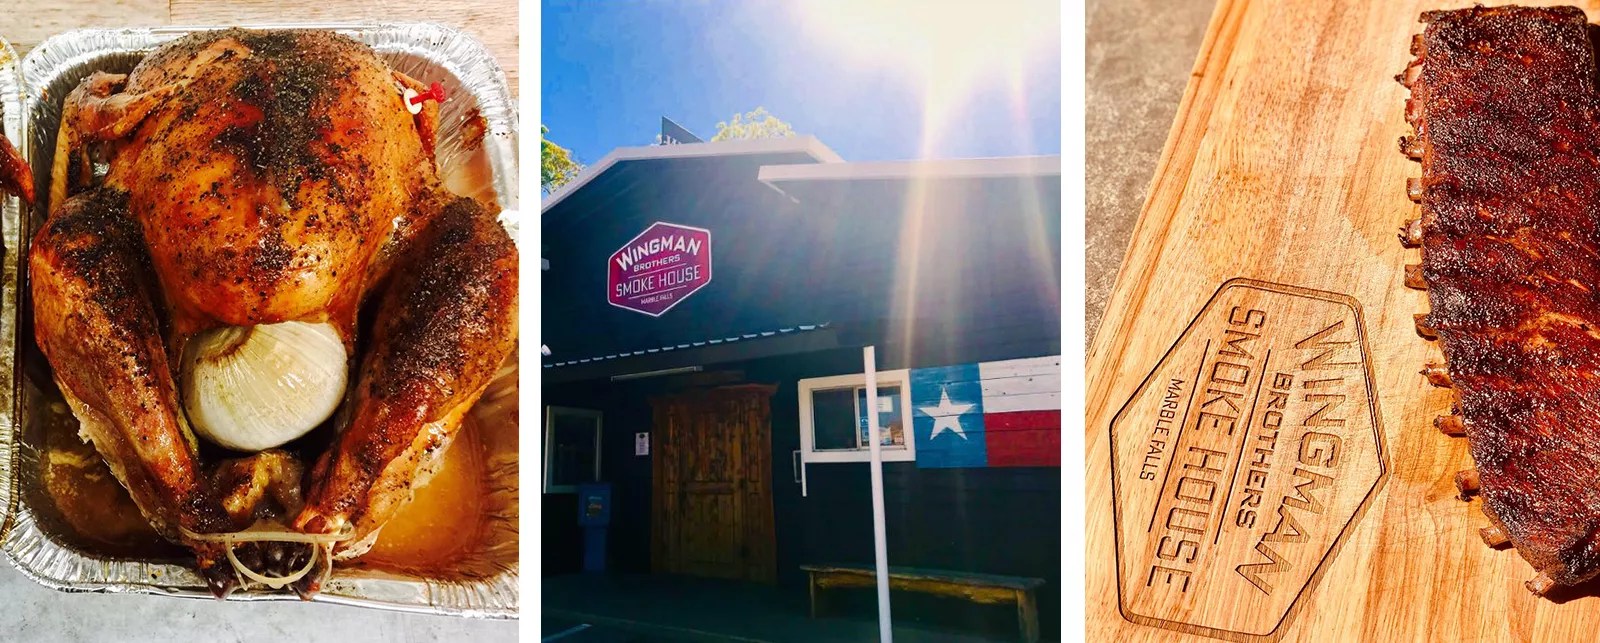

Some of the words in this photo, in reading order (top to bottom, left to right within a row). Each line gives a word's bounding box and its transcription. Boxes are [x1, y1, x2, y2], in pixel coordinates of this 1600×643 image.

[615, 235, 702, 271] WINGMAN
[616, 275, 655, 297] SMOKE
[659, 264, 702, 288] HOUSE
[633, 254, 681, 272] BROTHERS
[1194, 305, 1266, 436] SMOKE
[1153, 378, 1185, 437] MARBLE
[1139, 439, 1166, 481] FALLS
[1234, 320, 1358, 597] WINGMAN
[1235, 372, 1295, 530] BROTHERS
[1146, 446, 1228, 593] HOUSE
